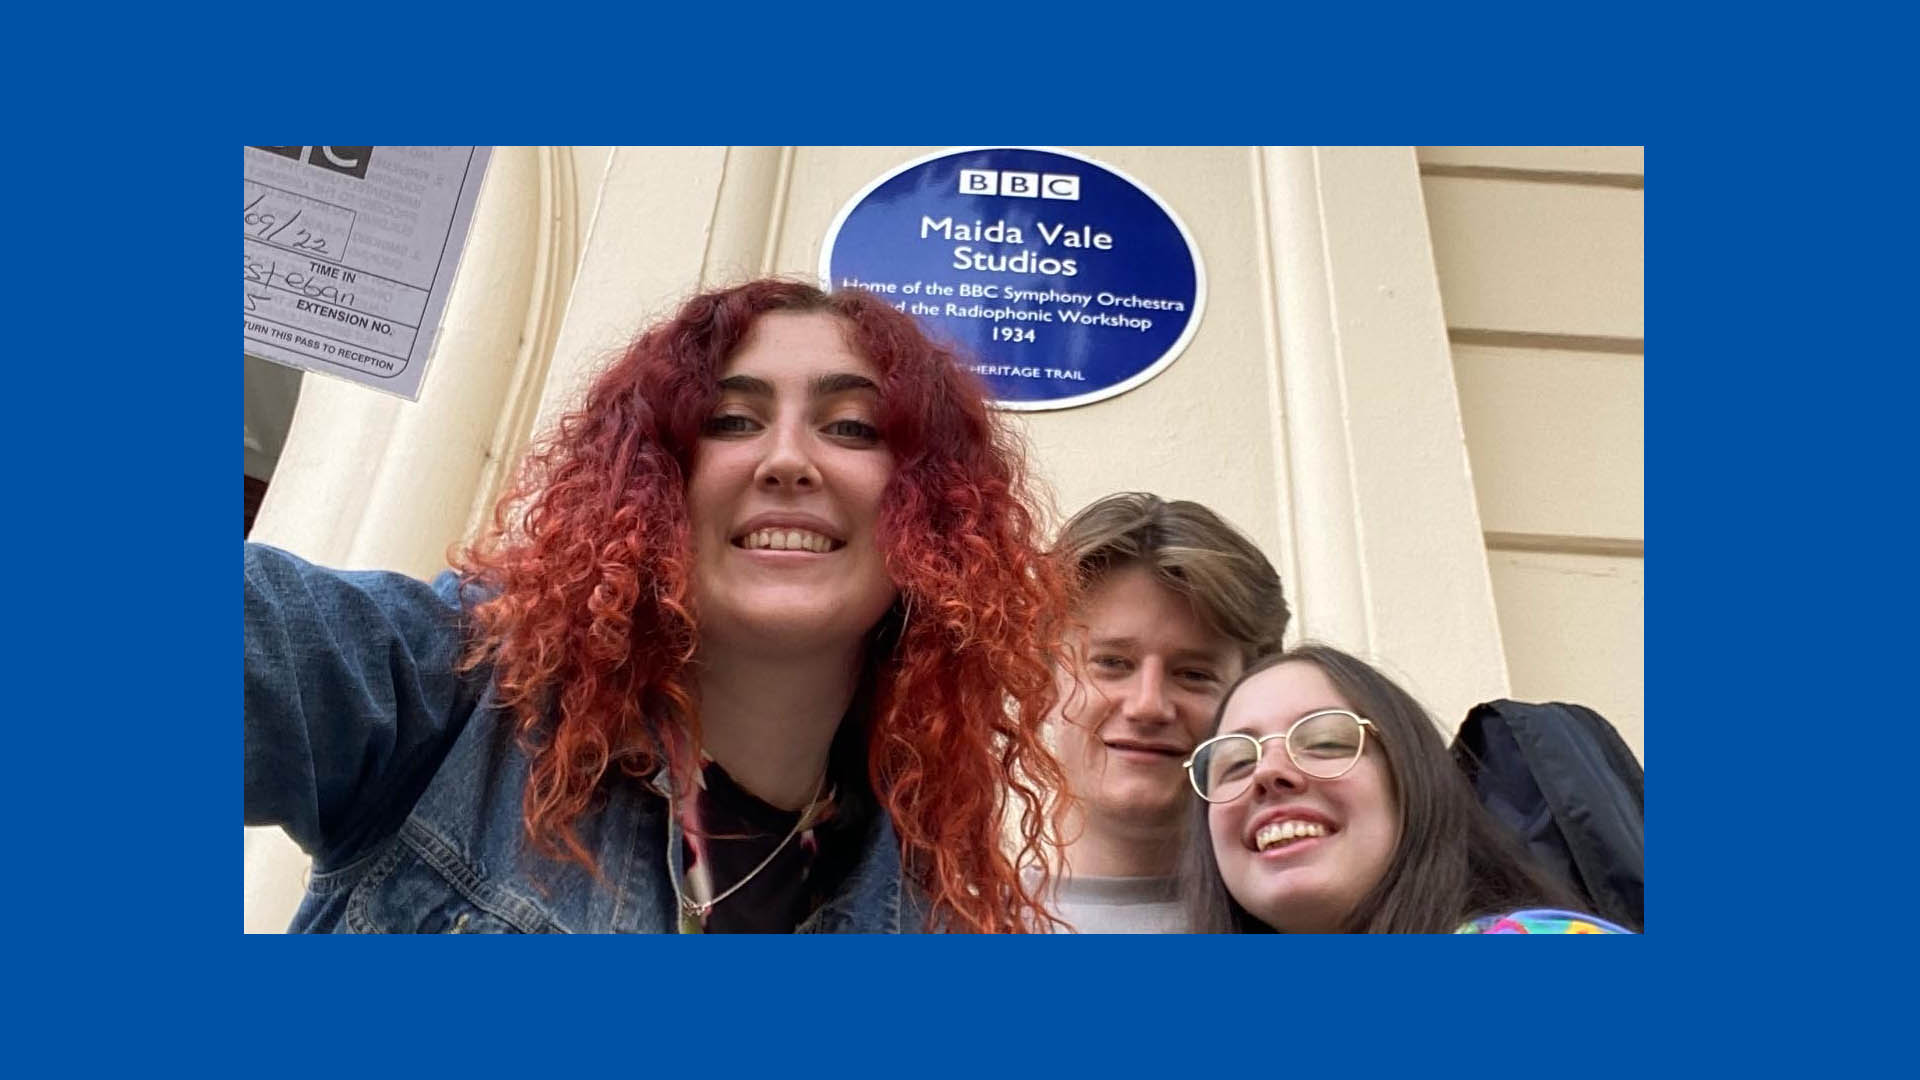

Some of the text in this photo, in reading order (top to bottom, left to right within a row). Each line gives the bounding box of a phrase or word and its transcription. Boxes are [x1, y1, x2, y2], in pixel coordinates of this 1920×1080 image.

[965, 171, 1077, 198] BBC
[920, 215, 1113, 250] Maida Vale
[309, 261, 357, 284] TIME IN
[953, 246, 1078, 277] Studios
[902, 280, 922, 295] of
[925, 281, 954, 297] the
[959, 283, 999, 299] BBC
[1003, 286, 1092, 308] Symphony
[1097, 291, 1185, 313] Orchestra
[296, 299, 393, 337] EXTENSION NO.
[911, 301, 940, 316] the
[945, 303, 1053, 323] Radiophonic
[1057, 309, 1153, 332] Workshop
[271, 328, 293, 342] THIS
[295, 335, 320, 350] PASS
[323, 343, 336, 354] TO
[338, 348, 394, 371] RECEPTION
[992, 326, 1036, 343] 1934
[1045, 368, 1086, 381] TRAIL
